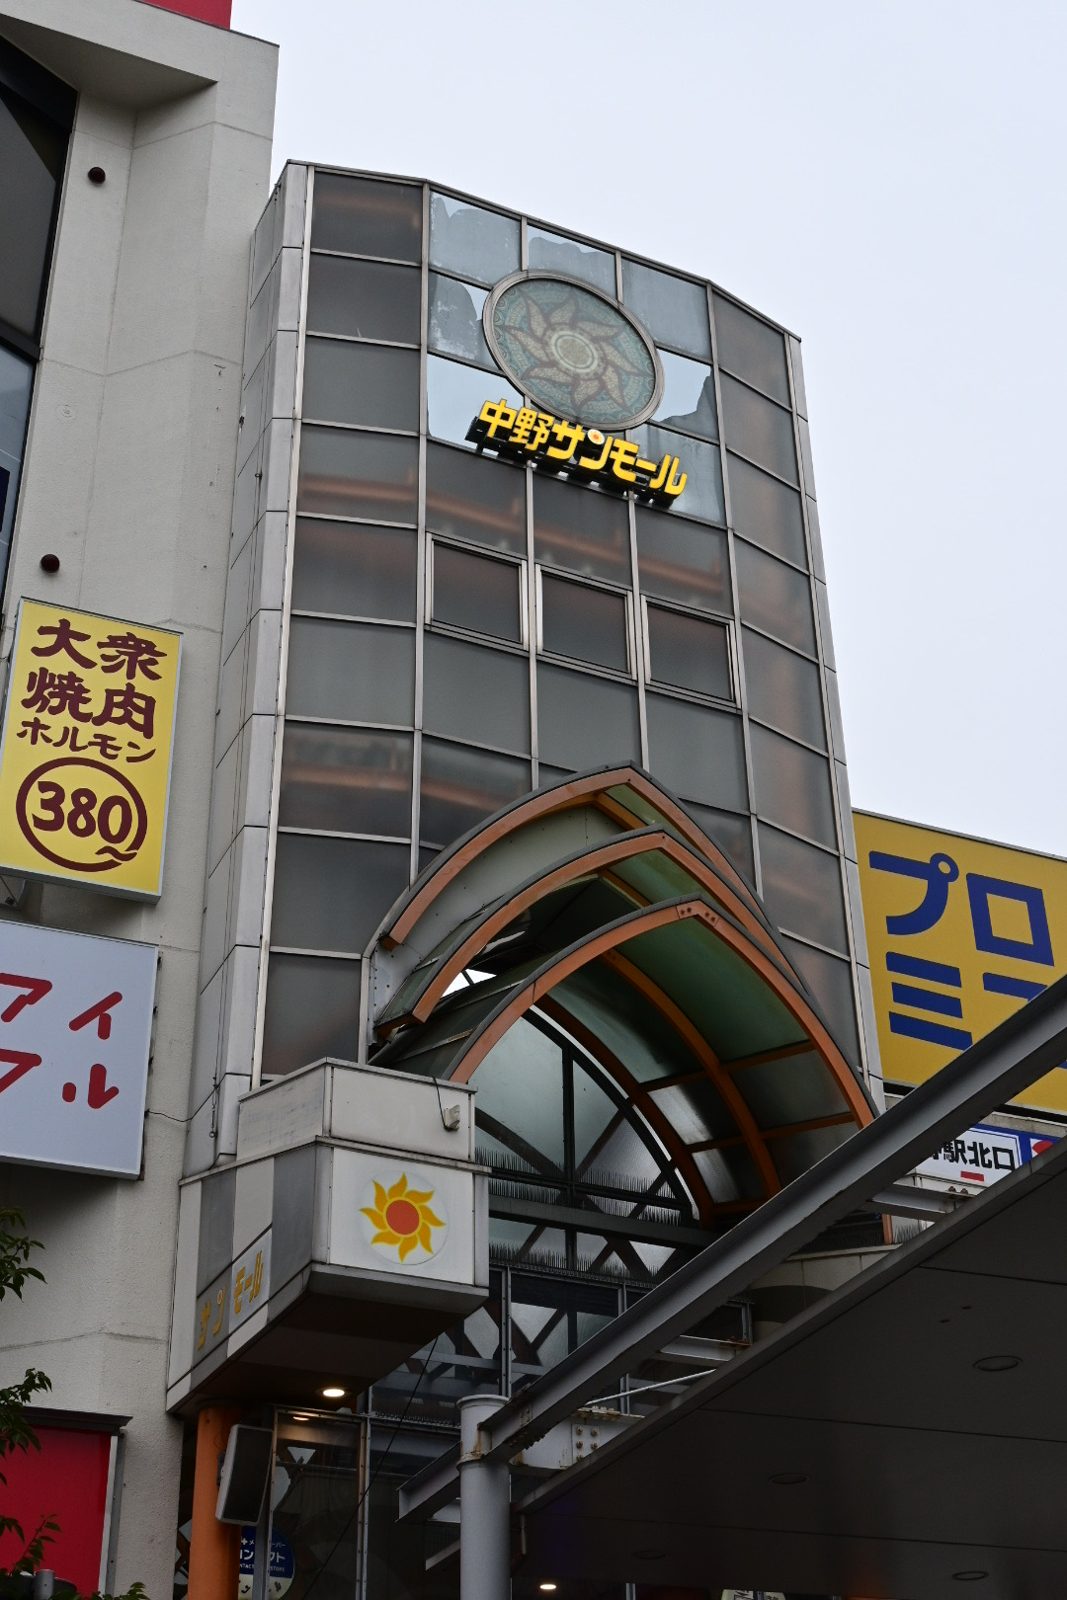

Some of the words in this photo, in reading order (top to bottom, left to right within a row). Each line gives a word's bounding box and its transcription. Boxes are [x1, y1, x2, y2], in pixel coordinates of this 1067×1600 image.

[478, 398, 687, 495] 中野サンモール
[30, 618, 168, 681] 大衆
[16, 716, 156, 763] ホルモン
[21, 667, 156, 740] 焼肉
[869, 851, 1054, 966] プロ
[0, 973, 123, 1040] アイ
[886, 951, 1048, 1050] ミ
[196, 1250, 264, 1351] サンモール
